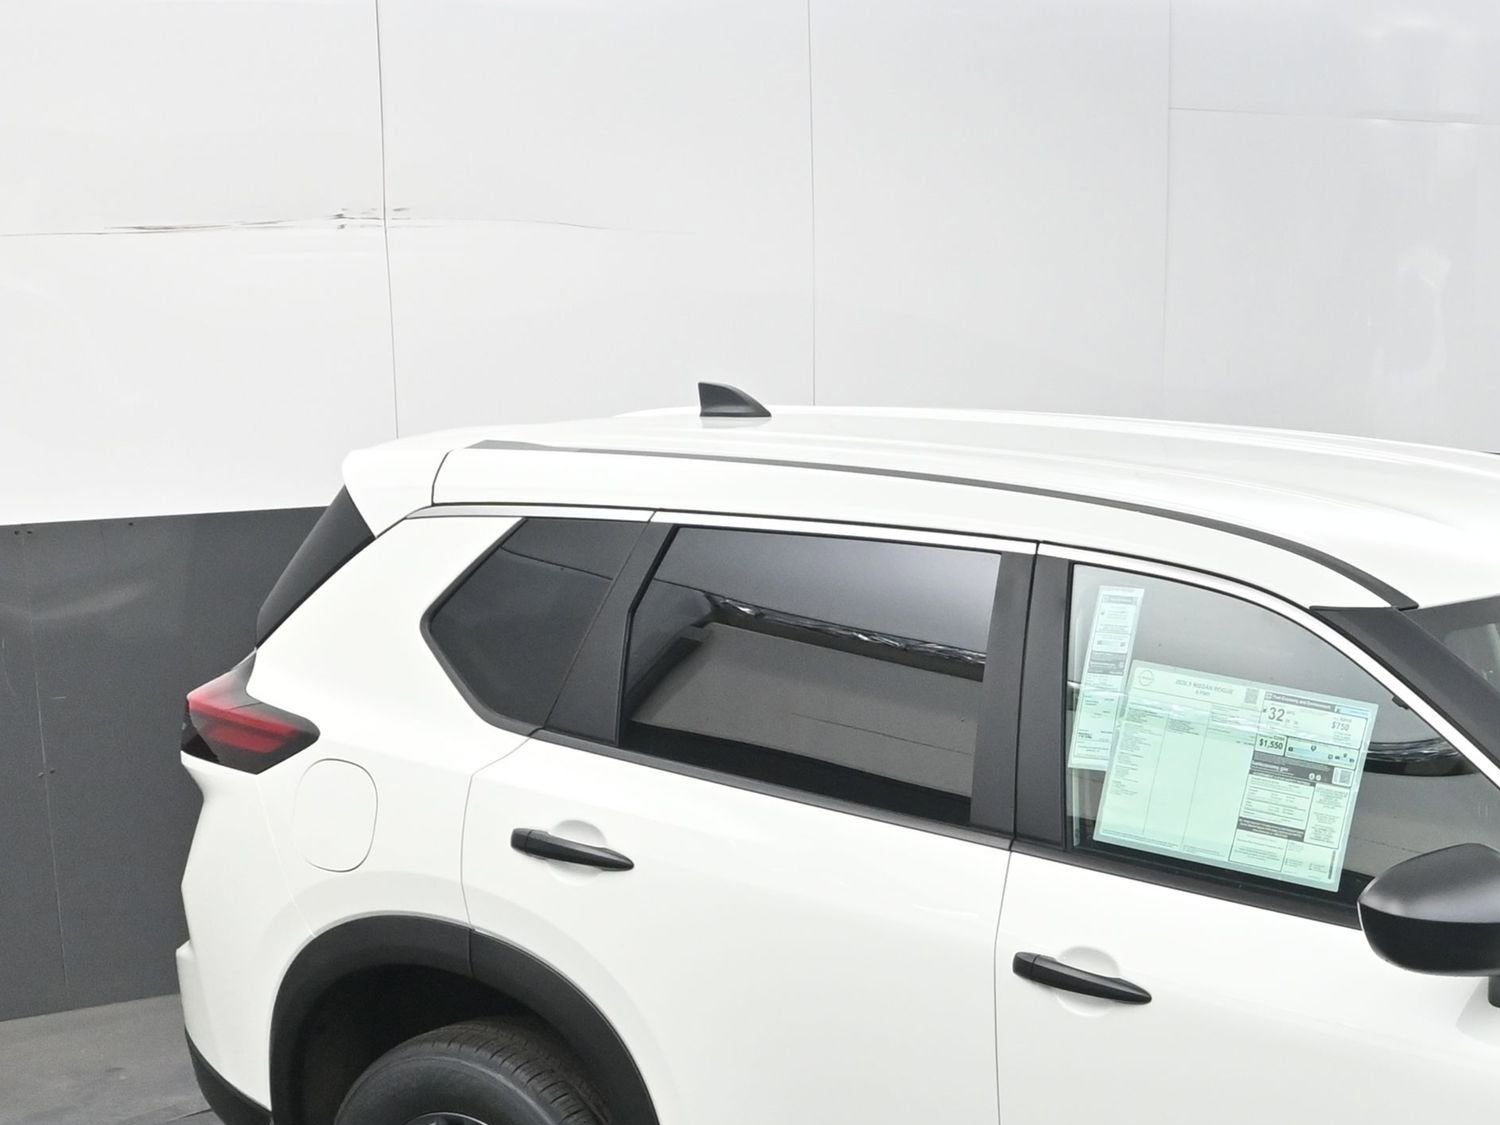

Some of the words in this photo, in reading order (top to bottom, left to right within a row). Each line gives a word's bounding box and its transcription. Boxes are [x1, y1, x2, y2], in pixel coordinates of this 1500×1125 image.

[1268, 706, 1285, 722] 32
[1331, 720, 1350, 732] $750
[1259, 738, 1284, 750] $1,550
